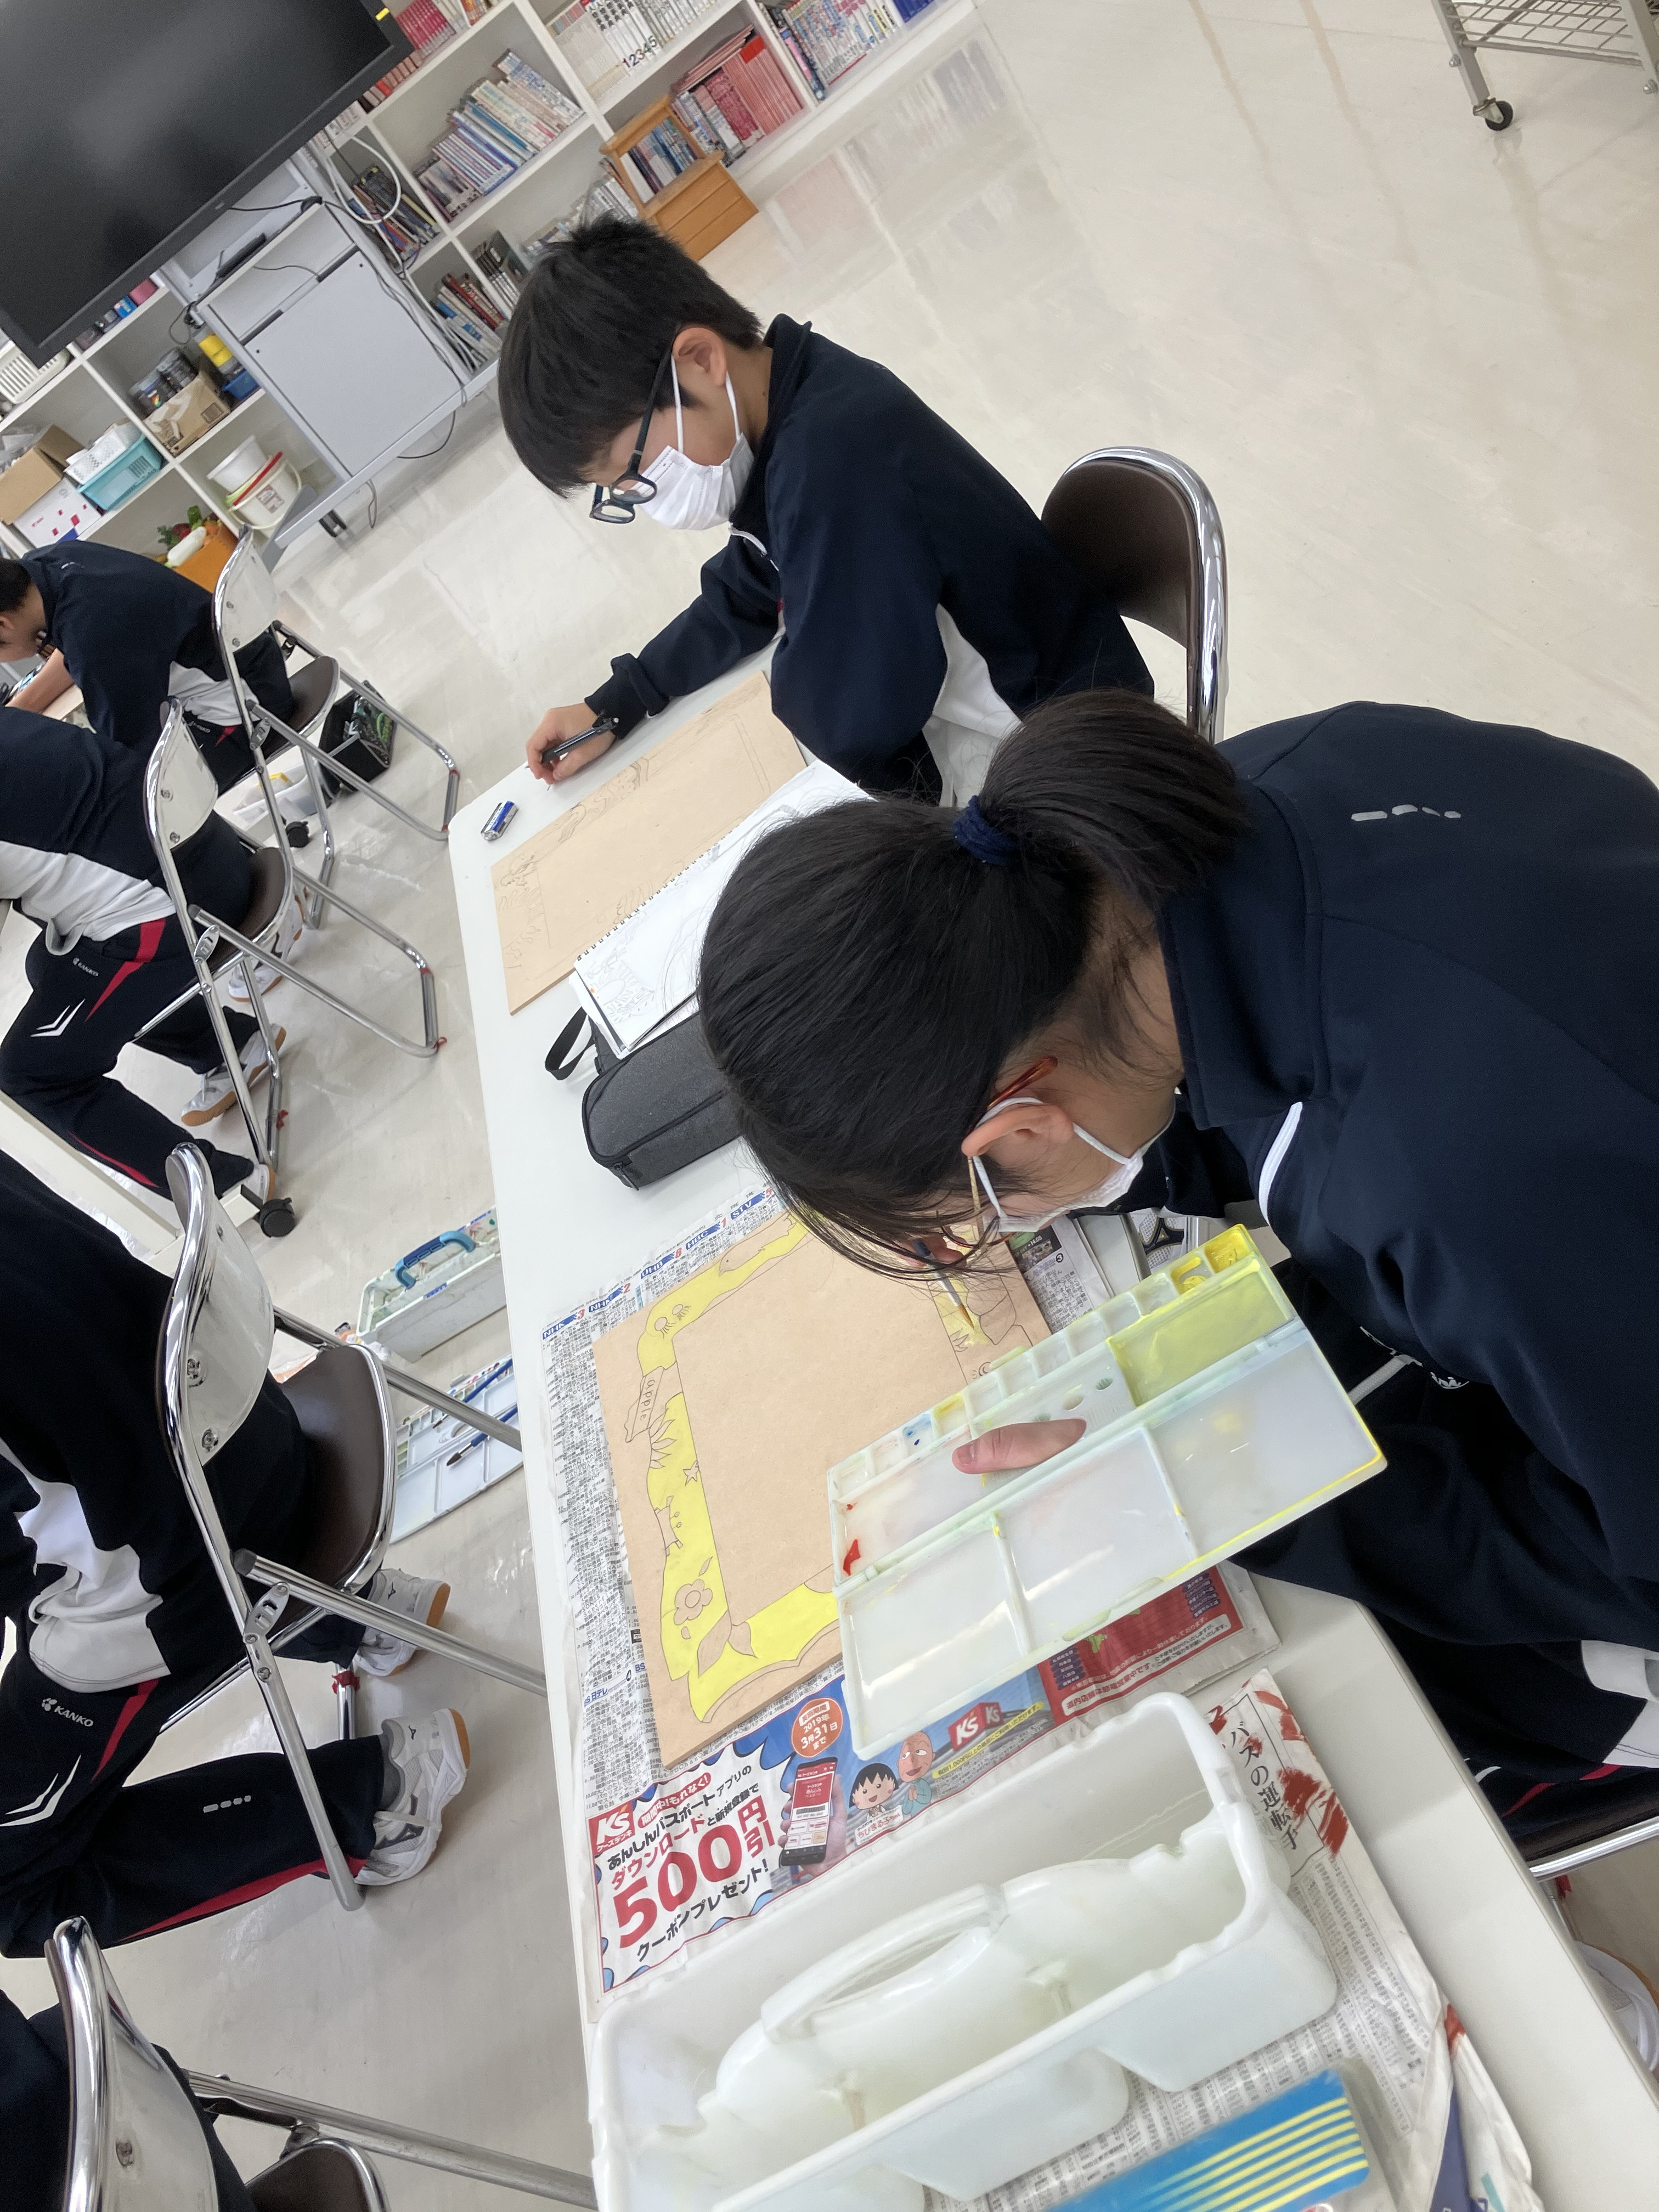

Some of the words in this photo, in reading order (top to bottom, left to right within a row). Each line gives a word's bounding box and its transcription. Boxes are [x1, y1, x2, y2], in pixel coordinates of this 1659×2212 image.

[644, 43, 652, 53] 4
[648, 35, 657, 48] 5
[623, 58, 630, 67] 1
[629, 54, 639, 66] 2
[636, 49, 645, 60] 3
[78, 962, 99, 977] KANKO
[732, 1200, 754, 1218] STV
[687, 1231, 709, 1249] HBC
[721, 1217, 727, 1228] 1
[642, 1261, 663, 1278] UHB
[674, 1248, 682, 1259] 8
[622, 1283, 631, 1294] 2
[543, 1321, 566, 1339] NHK
[576, 1308, 585, 1321] 3
[640, 1379, 656, 1421] apple
[635, 1662, 645, 1672] BS
[54, 1705, 94, 1728] KANKO
[803, 1714, 830, 1733] 2019年
[800, 1721, 838, 1750] 3月31日
[812, 1737, 827, 1750] まで
[1231, 1721, 1298, 1850] バスの運転手
[857, 1812, 901, 1839] ちびまる子ちゃん
[596, 1830, 633, 1852] ケーズデンキ
[613, 1824, 743, 1949] 500
[637, 1858, 769, 1962] クーポンプレゼント!
